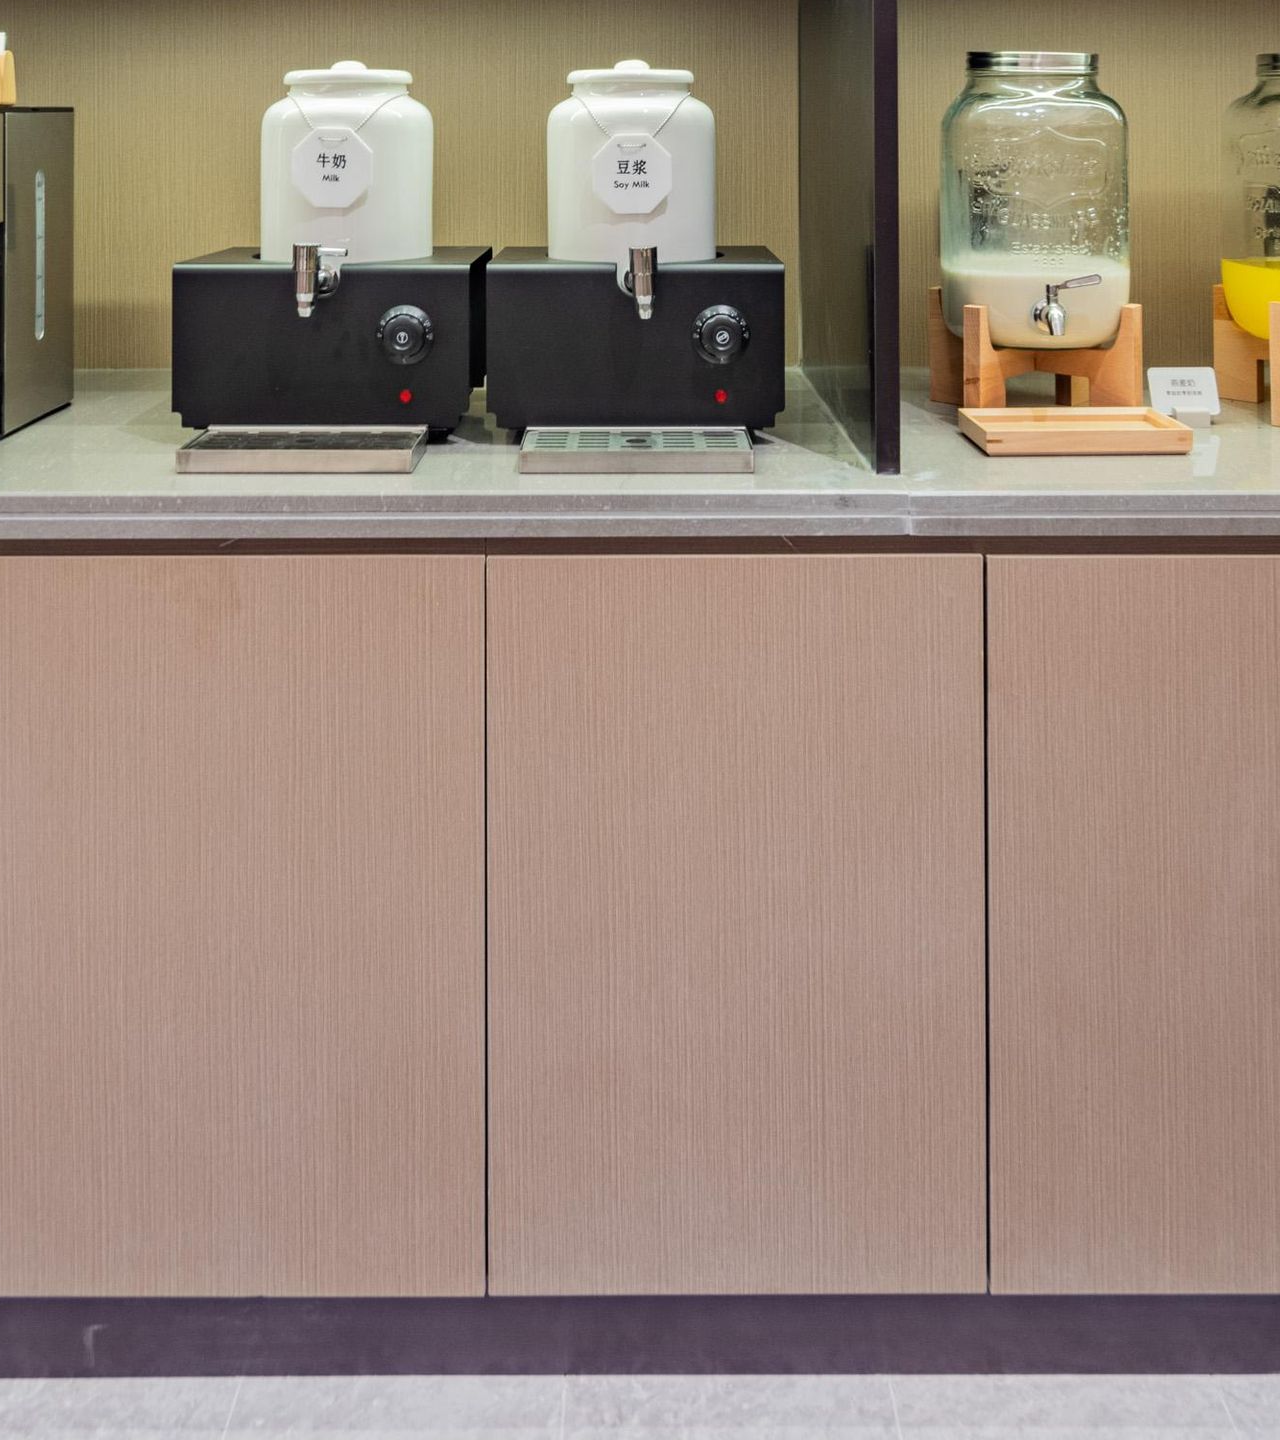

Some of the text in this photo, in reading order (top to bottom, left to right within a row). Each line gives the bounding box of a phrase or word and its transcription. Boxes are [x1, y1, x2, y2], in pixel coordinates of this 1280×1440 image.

[316, 153, 347, 169] 牛奶
[616, 160, 647, 175] 豆浆
[322, 174, 340, 182] Milk
[613, 180, 650, 190] Soy Milk
